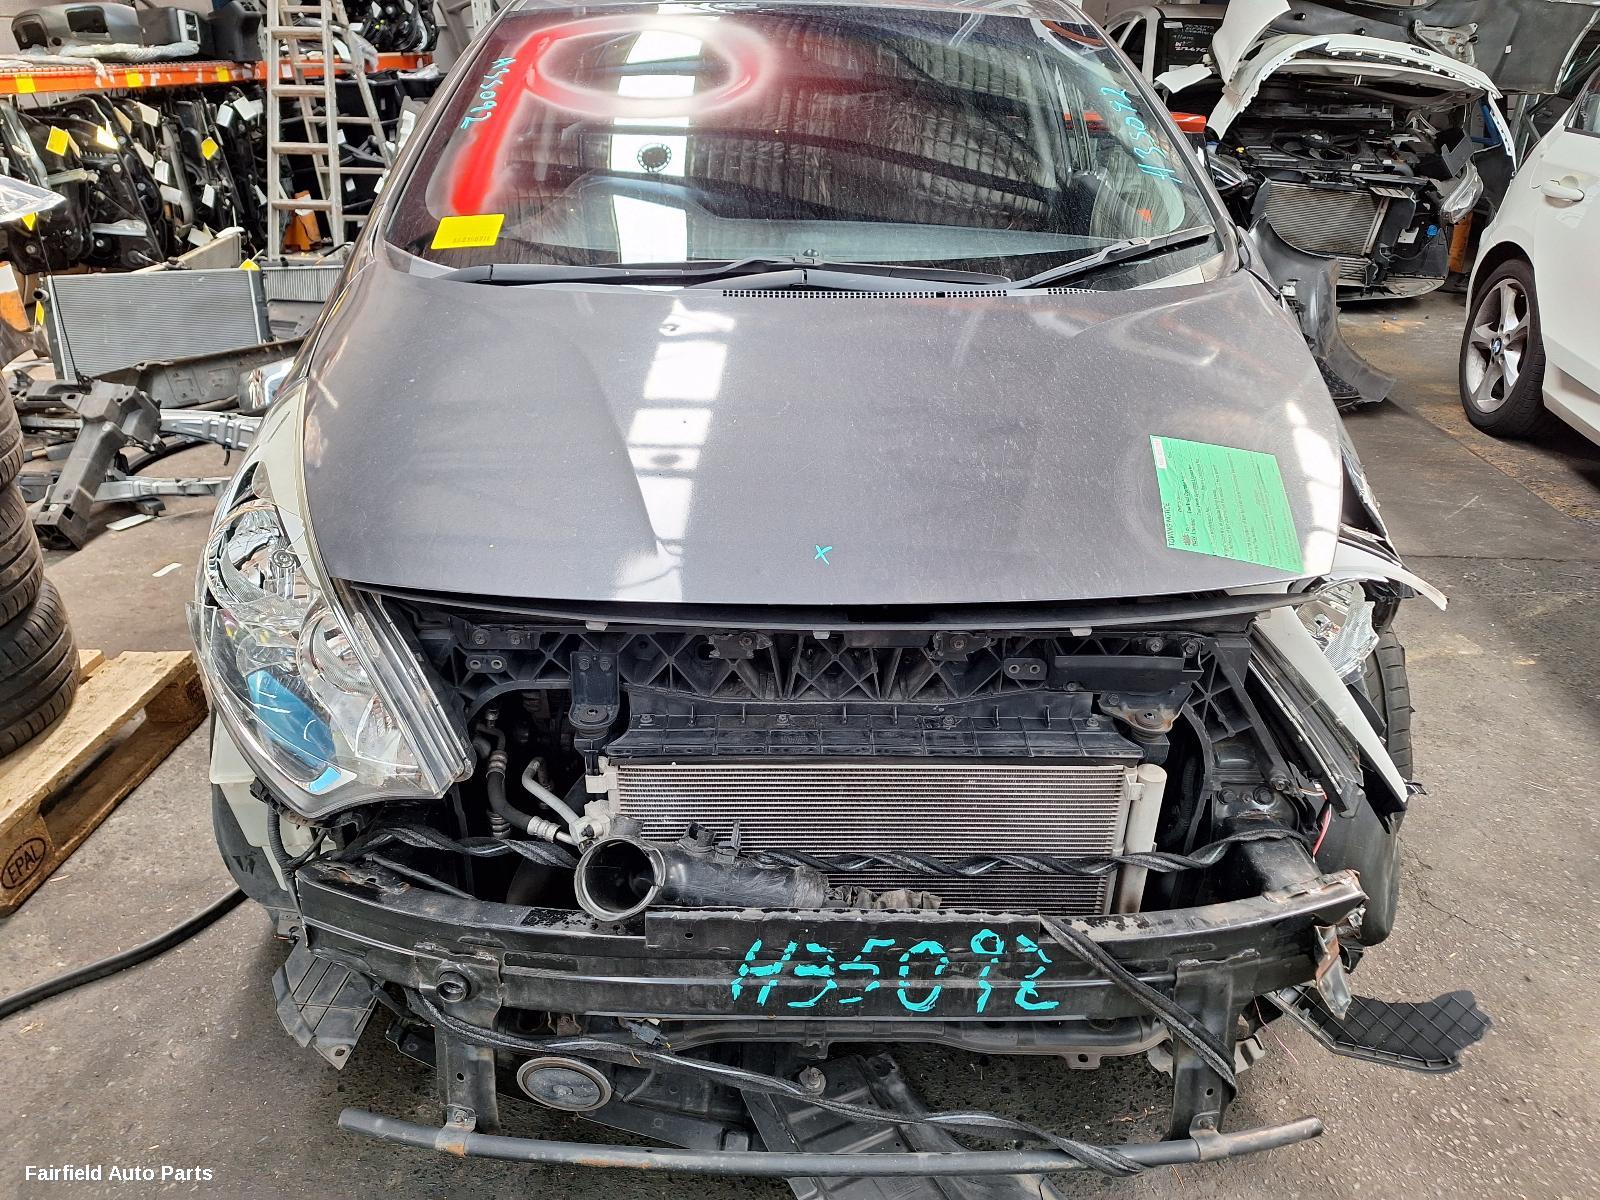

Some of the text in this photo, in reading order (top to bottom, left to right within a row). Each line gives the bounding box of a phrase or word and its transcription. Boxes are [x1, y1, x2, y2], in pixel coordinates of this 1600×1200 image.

[1100, 86, 1182, 184] H35092
[7, 845, 42, 884] EPAL
[731, 928, 1060, 1014] H35092
